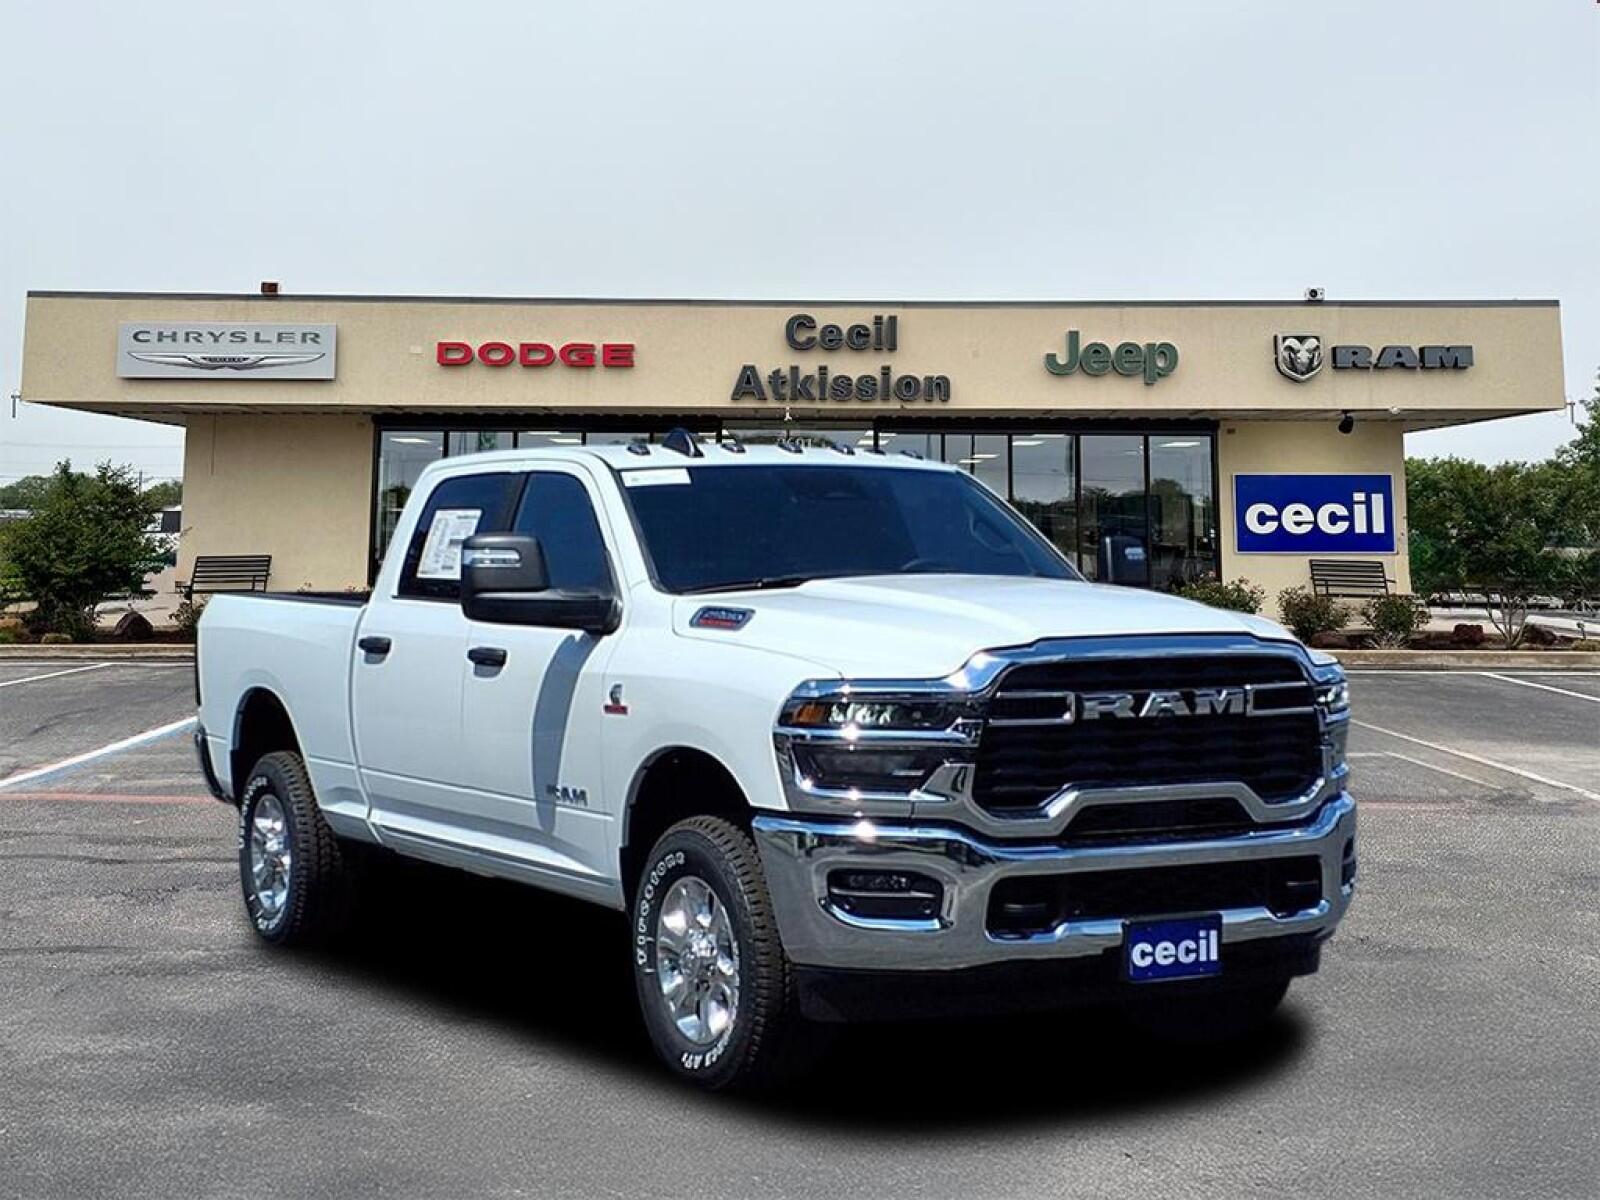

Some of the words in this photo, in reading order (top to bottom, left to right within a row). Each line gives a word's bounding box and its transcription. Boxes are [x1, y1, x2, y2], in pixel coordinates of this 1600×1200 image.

[132, 330, 322, 344] CHRYSLER
[786, 313, 898, 351] Cecil
[436, 341, 636, 368] DODGE
[1045, 329, 1179, 386] Jeep
[1331, 344, 1474, 370] RAM
[731, 364, 951, 402] Atkission
[1244, 491, 1386, 535] cecil
[1081, 689, 1247, 720] RAM
[1131, 929, 1219, 968] cecil
